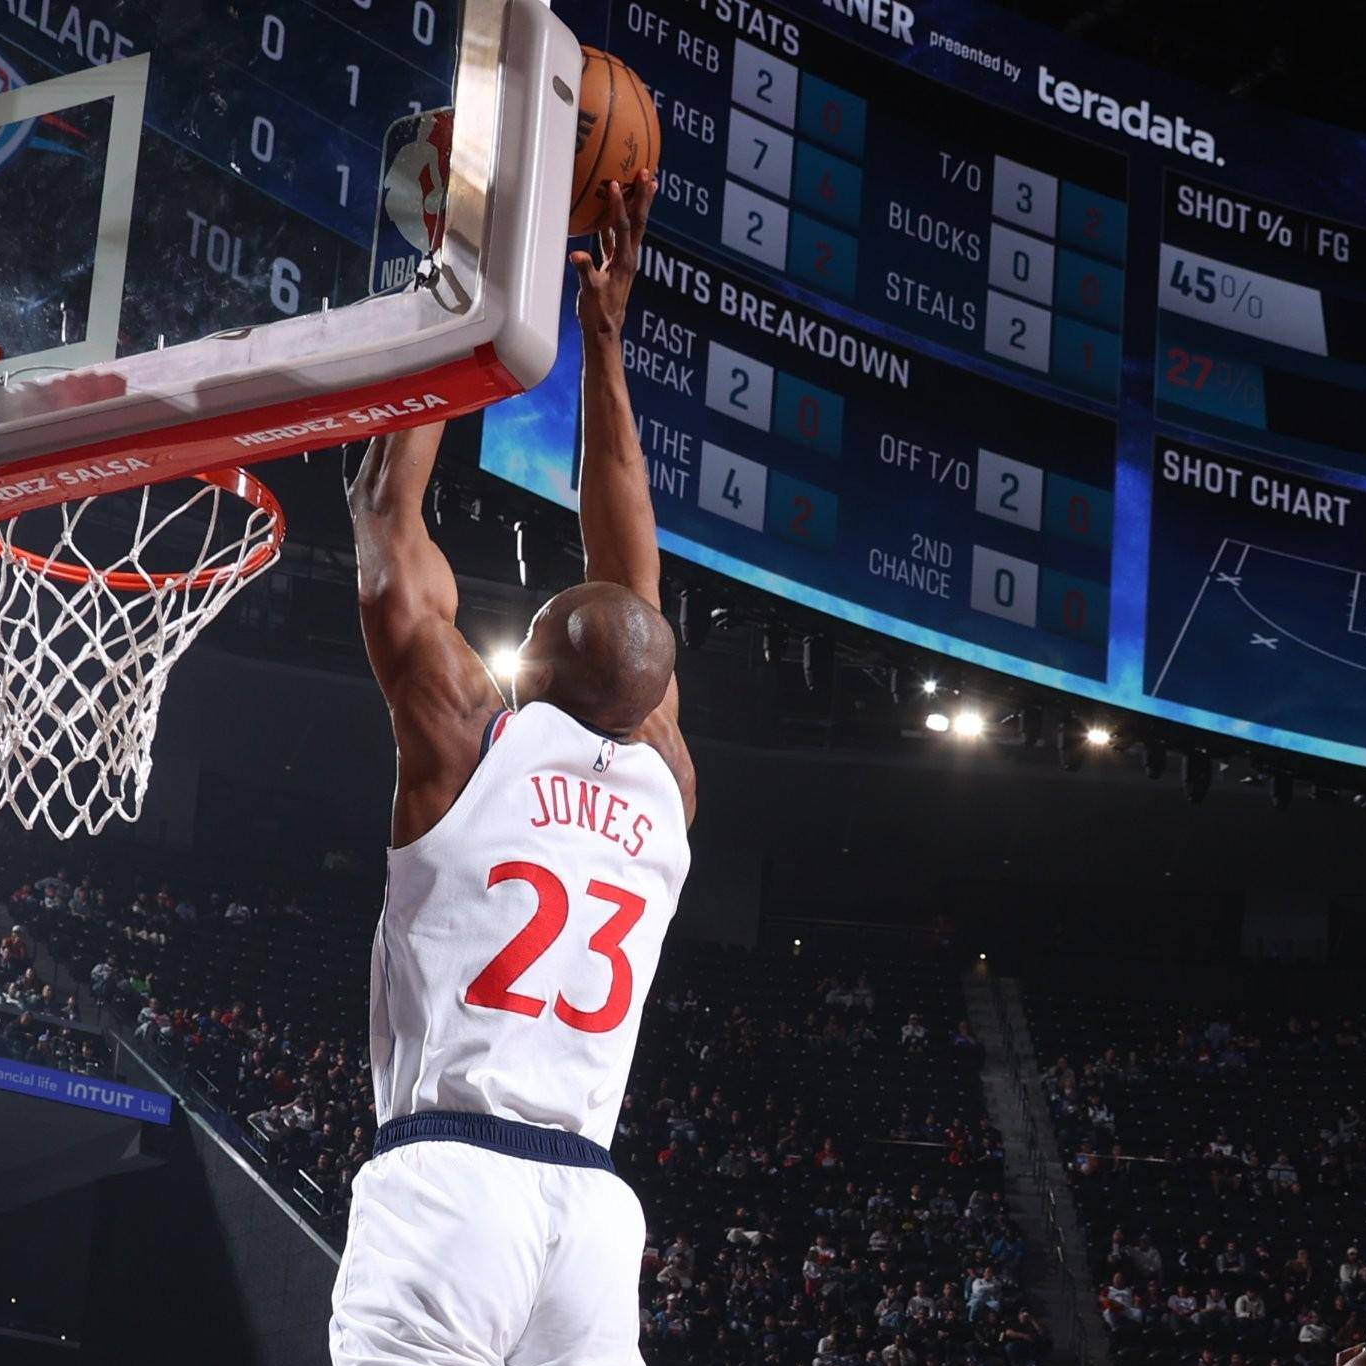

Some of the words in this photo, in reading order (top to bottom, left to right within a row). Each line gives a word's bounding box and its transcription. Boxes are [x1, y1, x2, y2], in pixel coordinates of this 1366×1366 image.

[7, 0, 134, 66] LLACE
[261, 14, 285, 61] 0
[346, 64, 361, 107] 1
[628, 4, 670, 45] OFF
[677, 29, 720, 73] REB
[756, 69, 774, 103] 2
[930, 31, 1001, 71] presented
[1003, 59, 1022, 83] by
[673, 101, 715, 144] REB
[753, 137, 769, 170] 7
[1038, 66, 1227, 167] teradata.
[250, 115, 275, 163] 0
[336, 164, 351, 207] 1
[939, 152, 982, 192] T/O
[1016, 182, 1034, 214] 3
[652, 167, 710, 217] ISTS
[746, 211, 764, 246] 2
[888, 201, 981, 262] BLOCKS
[1013, 250, 1030, 283] 0
[1177, 185, 1251, 234] SHOT
[1258, 210, 1293, 247] %
[1318, 228, 1350, 263] FG
[186, 210, 253, 281] TOL
[270, 256, 301, 315] 6
[380, 254, 416, 290] NBA
[1170, 260, 1264, 320] 45%
[636, 245, 711, 304] INTS
[720, 281, 910, 389] BREAKDOWN
[641, 309, 697, 360] FAST
[886, 271, 976, 331] STEALS
[1009, 317, 1027, 351] 2
[622, 339, 695, 397] BREAK
[730, 367, 750, 410] 2
[235, 417, 343, 447] HERDEZ
[352, 393, 449, 425] SALSA
[649, 419, 693, 465] THE
[59, 457, 151, 487] SALSA
[644, 455, 691, 498] INT
[721, 468, 742, 509] 4
[880, 433, 923, 472] OFF
[928, 451, 971, 490] T/O
[999, 472, 1020, 512] 2
[1163, 450, 1243, 498] SHOT
[1250, 475, 1352, 527] CHART
[869, 548, 952, 600] CHANCE
[994, 568, 1015, 608] 0
[911, 533, 952, 569] 2ND
[530, 775, 653, 857] JONES
[464, 860, 647, 1034] 23
[37, 1075, 58, 1092] life
[66, 1080, 135, 1110] INTUIT
[140, 1099, 166, 1116] Live
